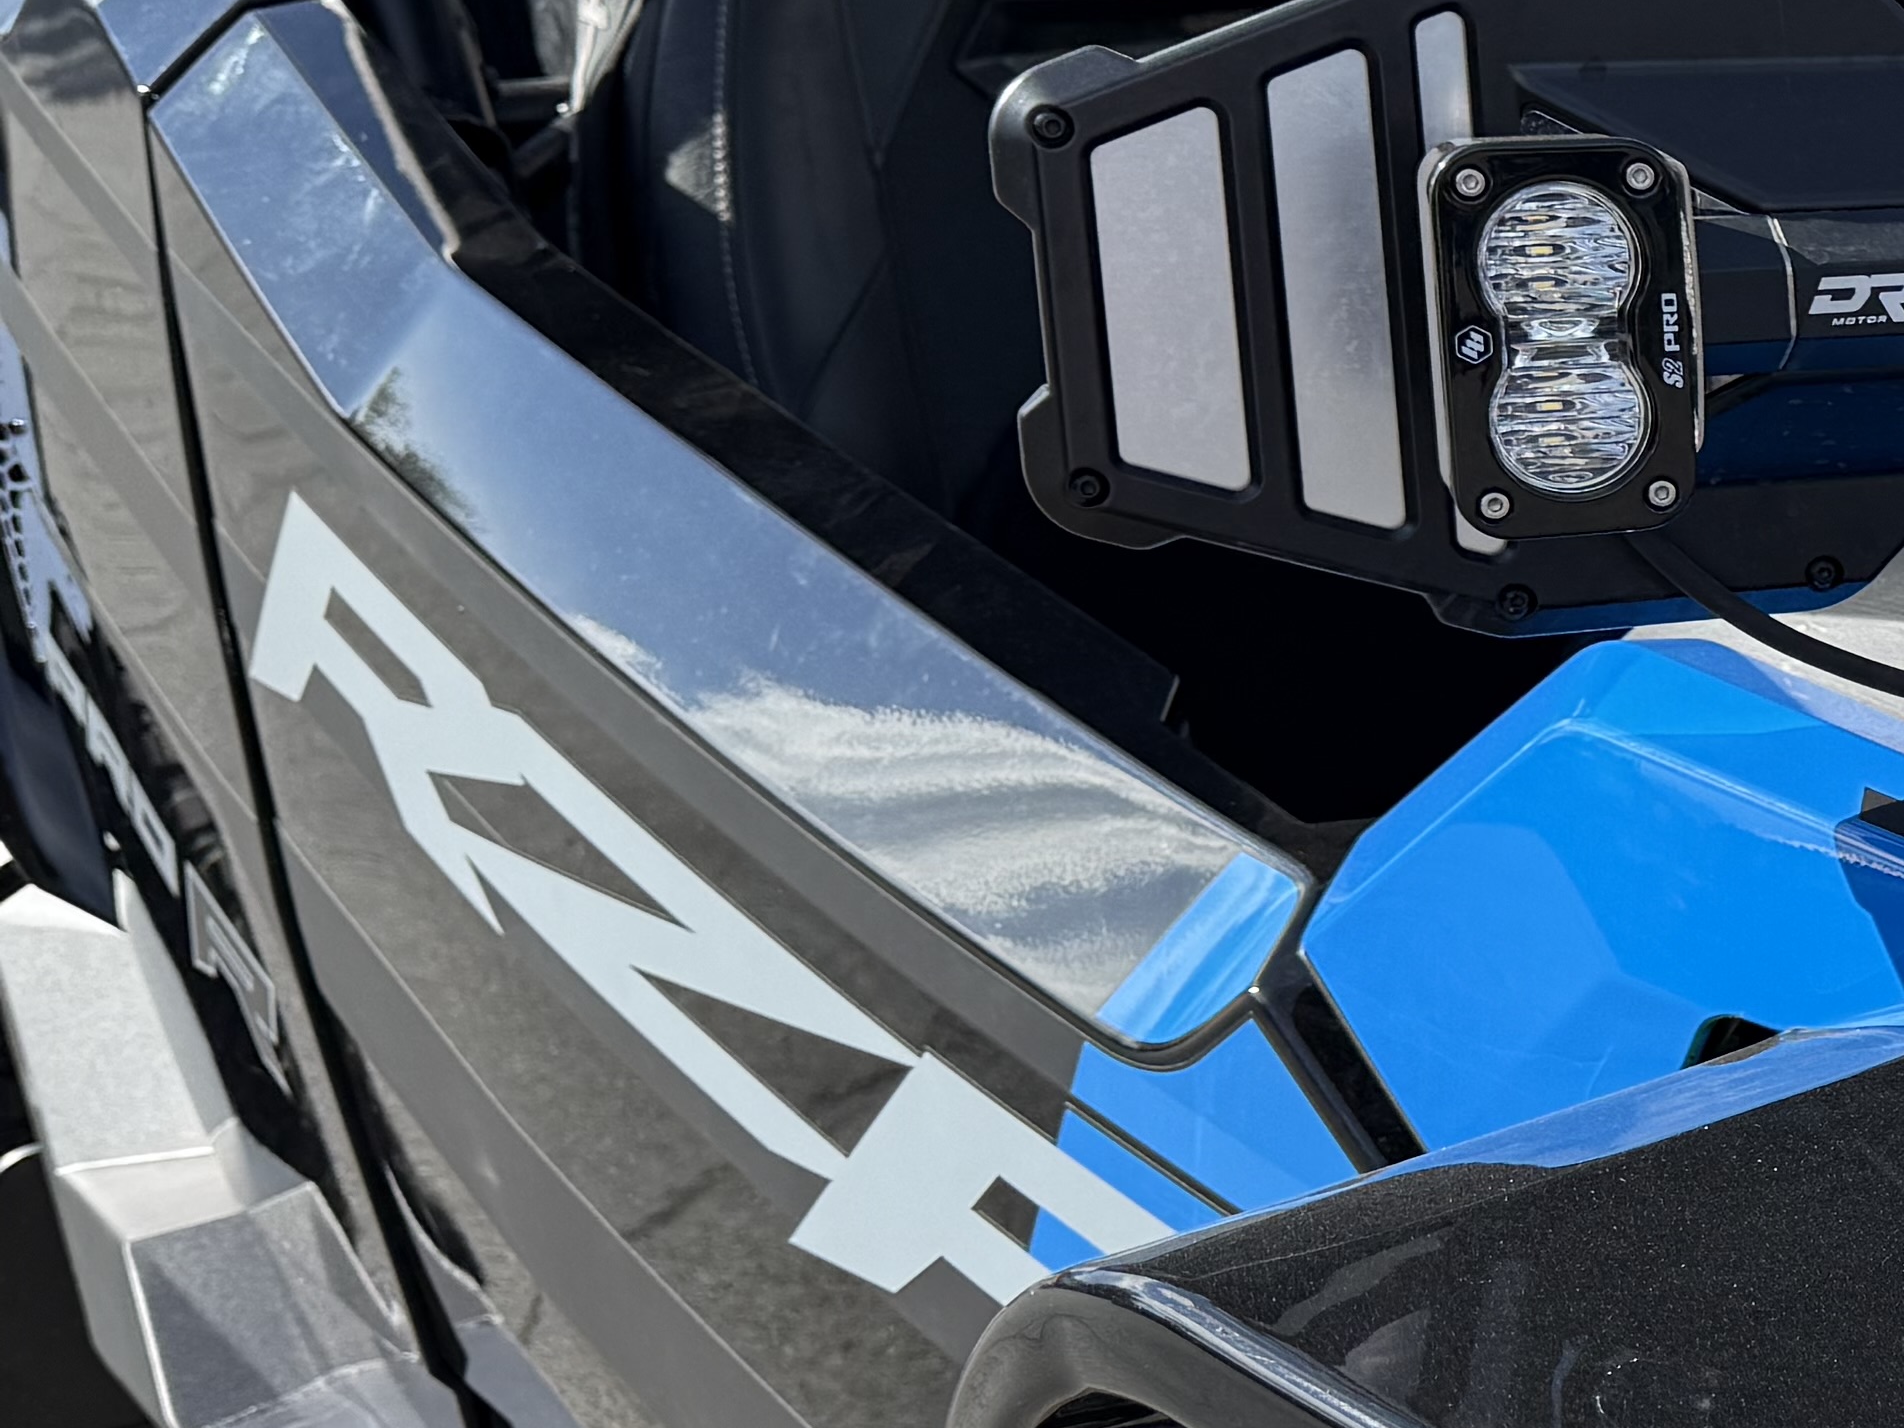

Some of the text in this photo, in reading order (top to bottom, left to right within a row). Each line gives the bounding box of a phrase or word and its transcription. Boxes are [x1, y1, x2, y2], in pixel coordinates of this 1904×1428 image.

[1660, 292, 1685, 389] S2 PRO
[1831, 314, 1888, 327] MOTOR
